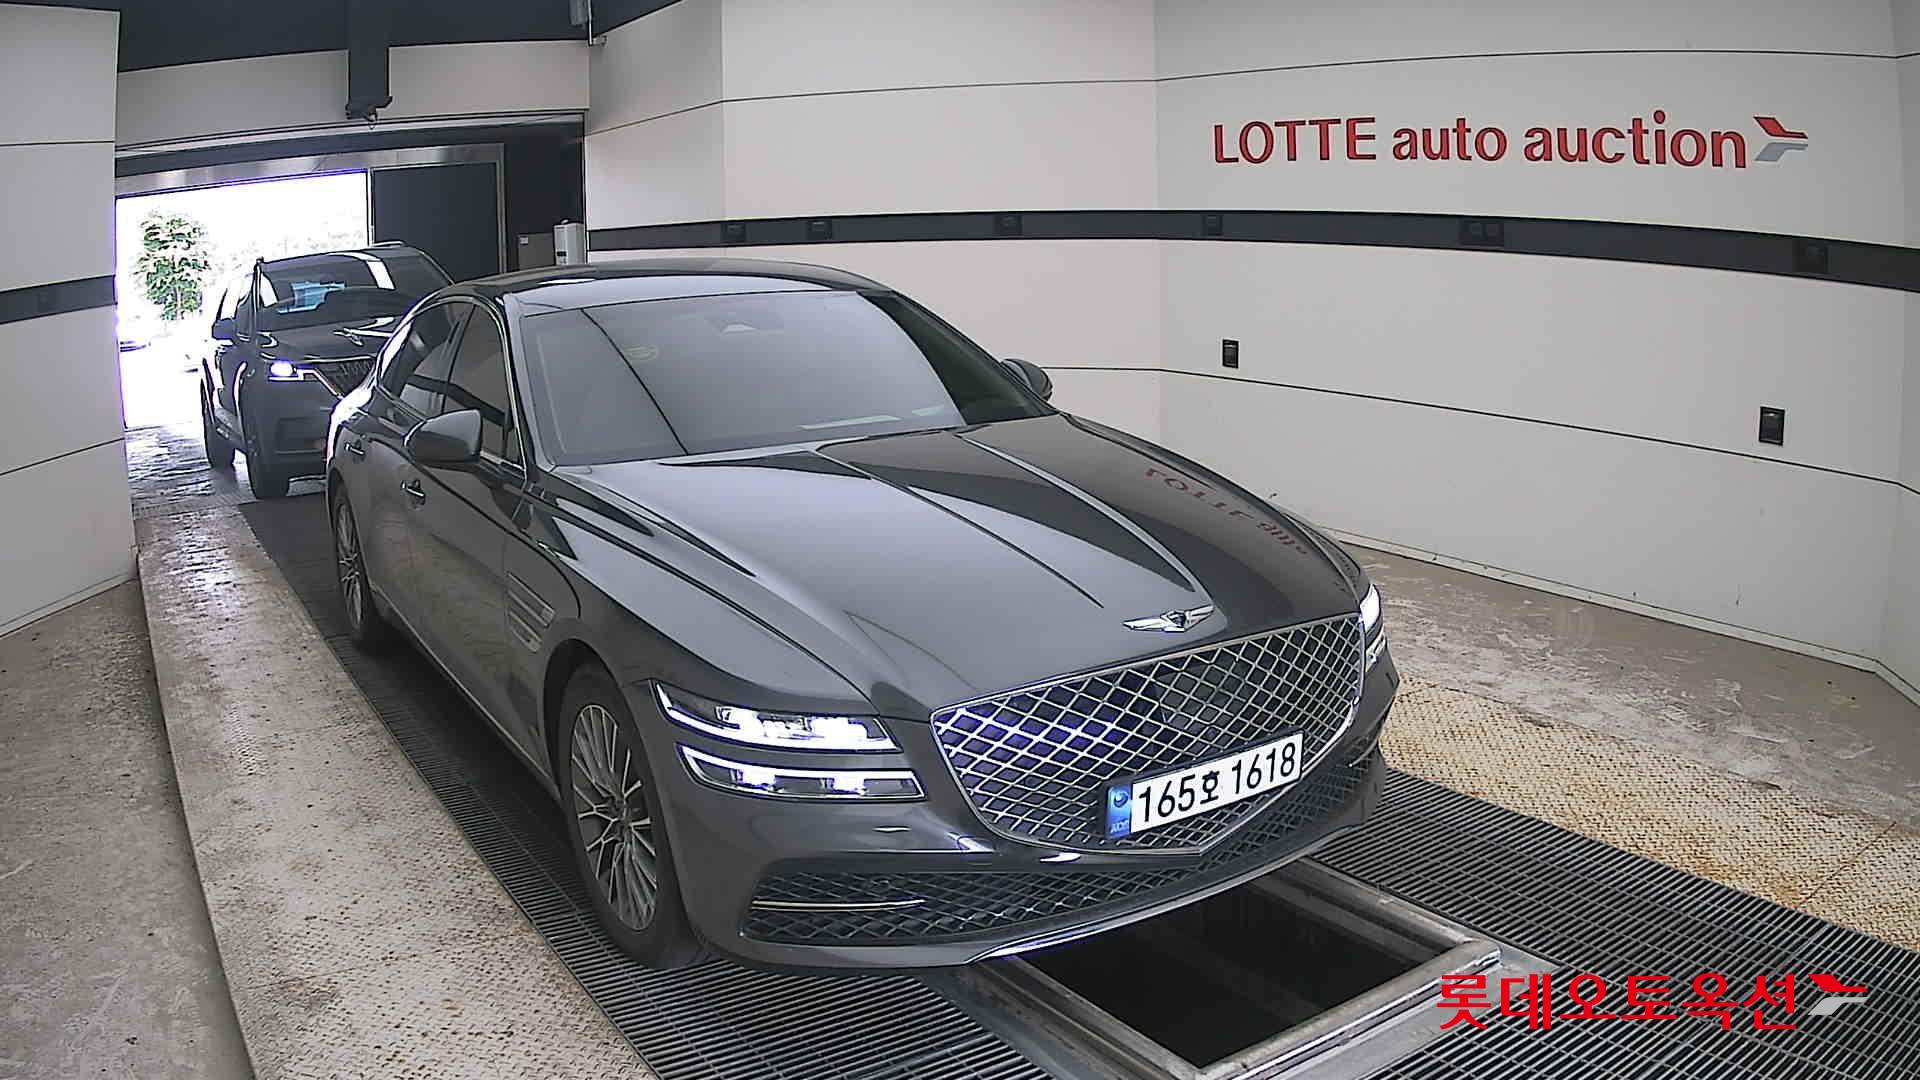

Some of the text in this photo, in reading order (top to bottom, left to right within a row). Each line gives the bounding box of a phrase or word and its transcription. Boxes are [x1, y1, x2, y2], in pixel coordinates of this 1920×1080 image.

[1213, 110, 1747, 168] LOTTE auto auction
[1138, 741, 1297, 823] 165호 1618
